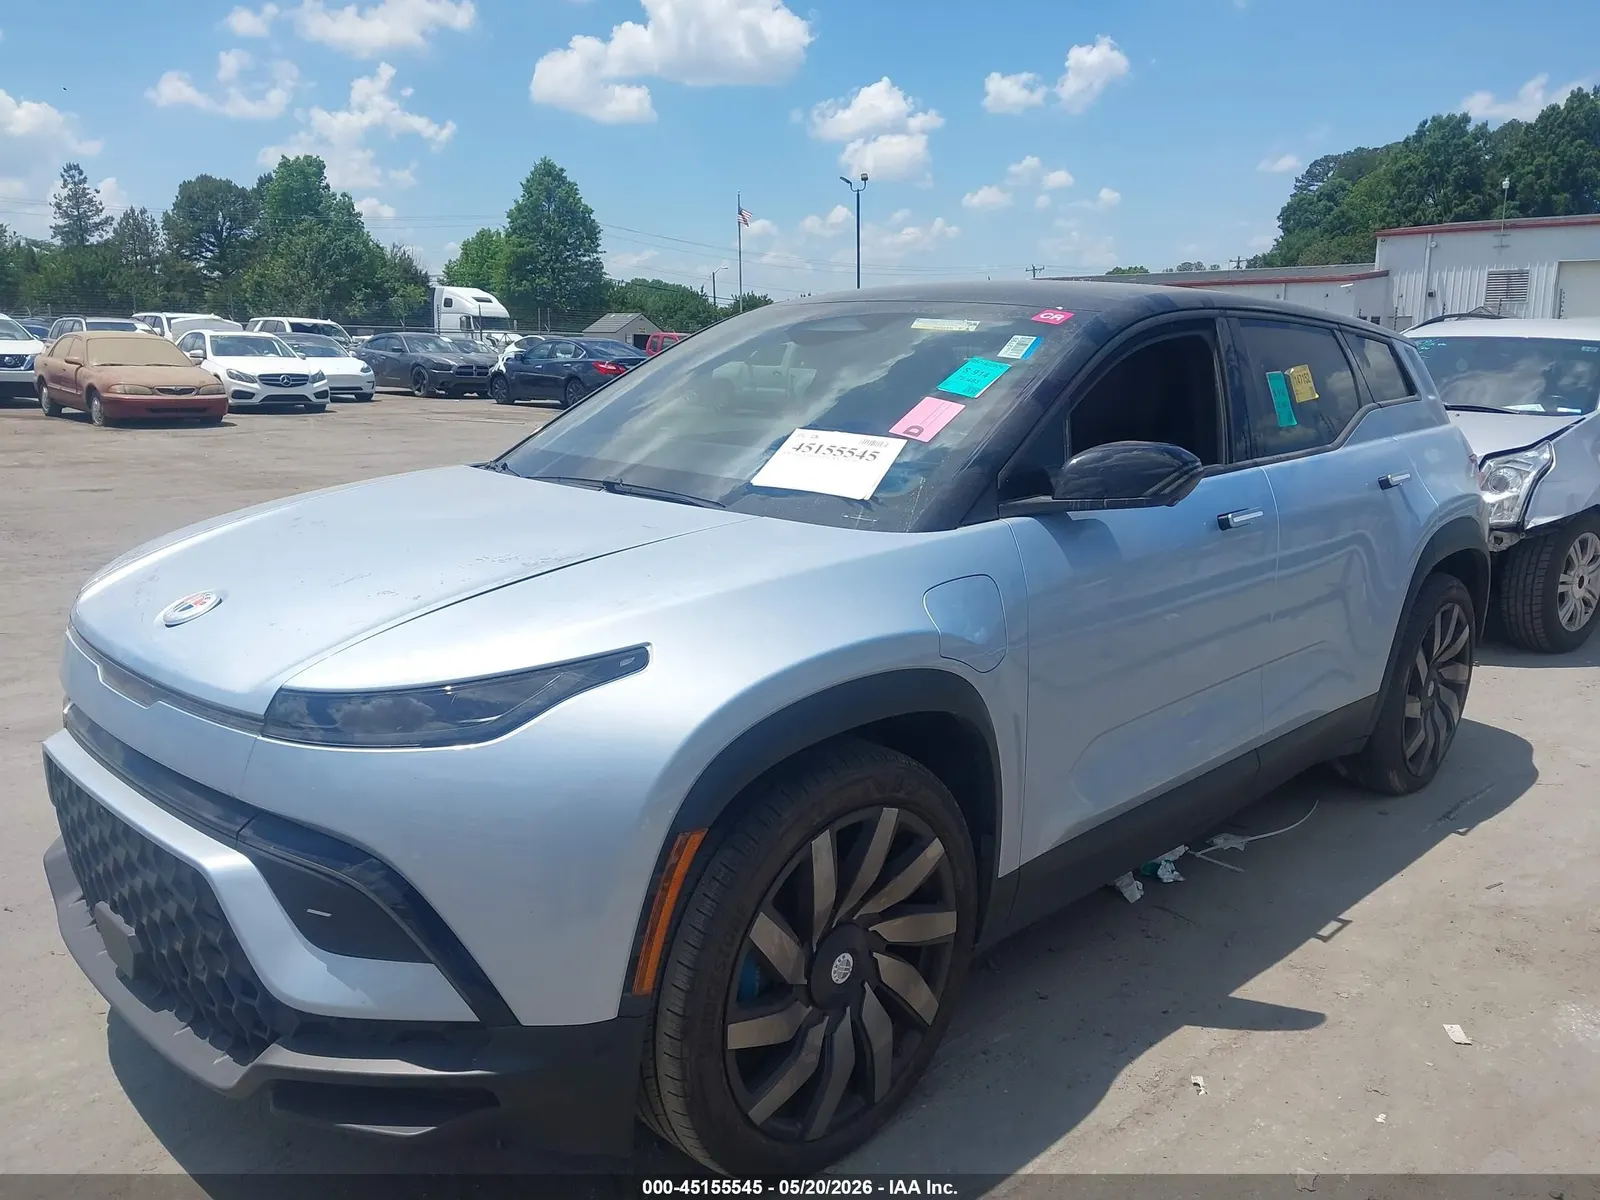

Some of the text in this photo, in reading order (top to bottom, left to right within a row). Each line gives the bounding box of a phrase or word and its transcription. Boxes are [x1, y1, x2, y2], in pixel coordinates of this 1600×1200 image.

[1040, 312, 1065, 321] CR
[973, 369, 991, 378] 914
[903, 425, 925, 438] D
[792, 442, 880, 462] 45155545
